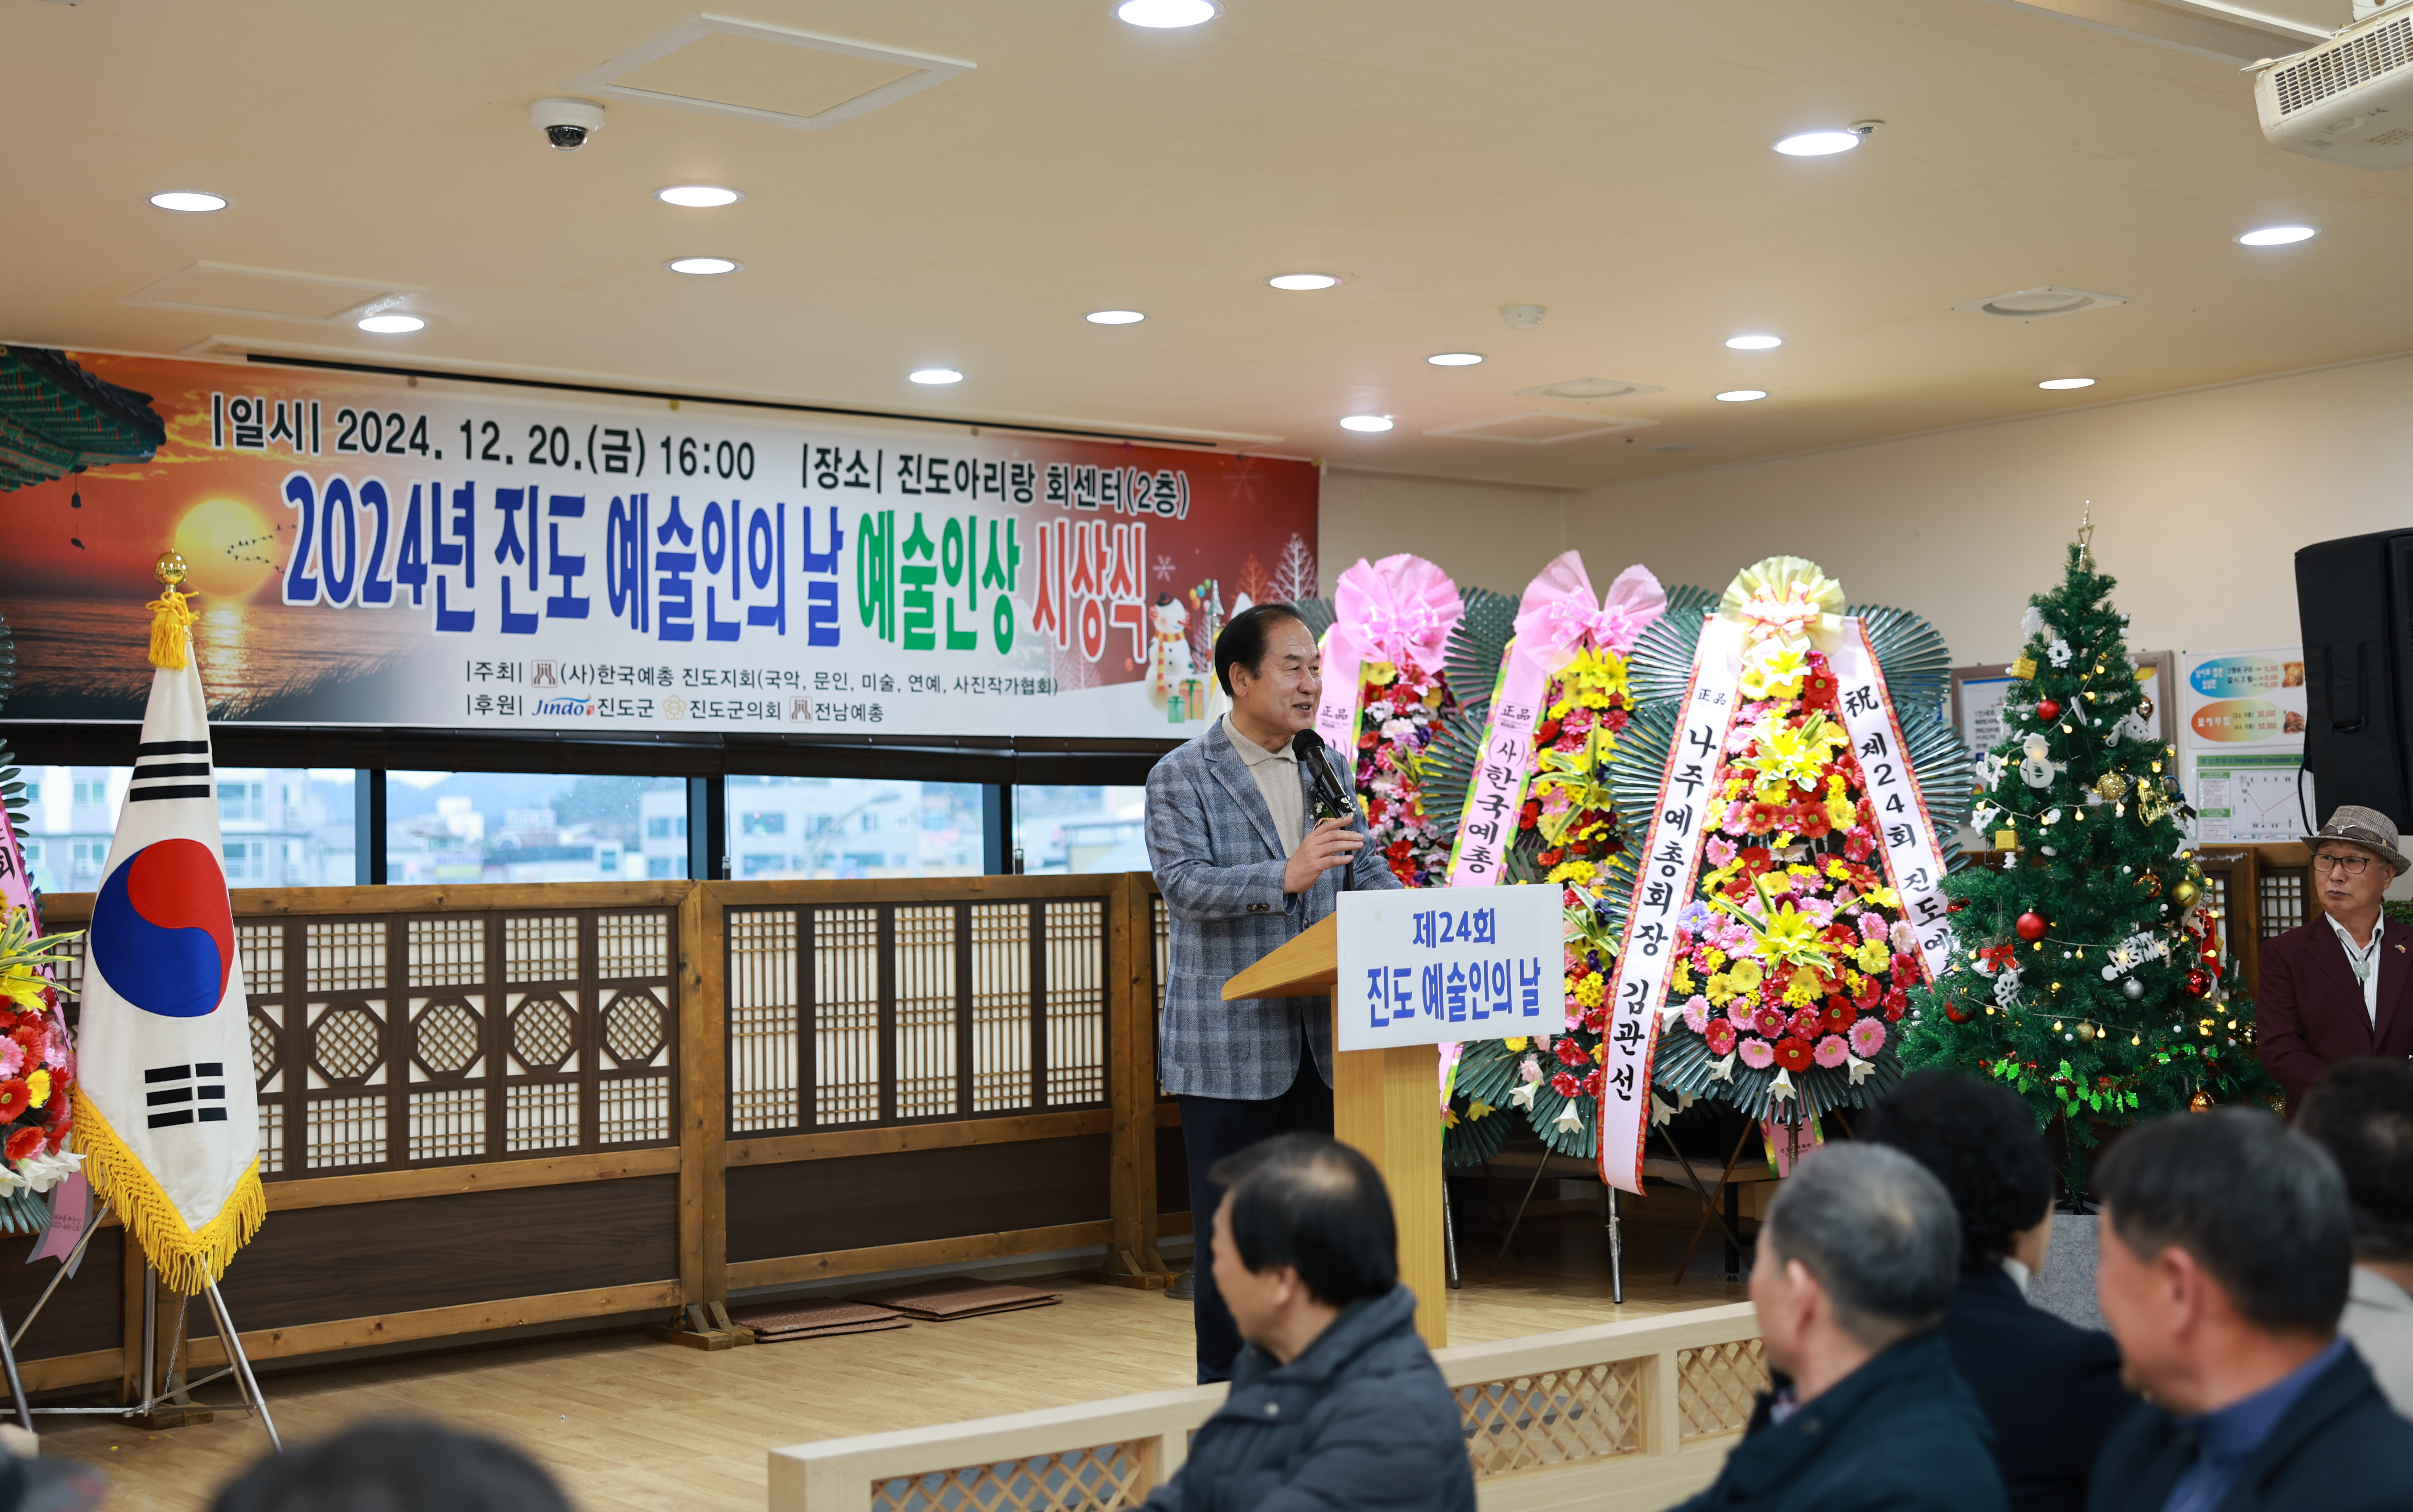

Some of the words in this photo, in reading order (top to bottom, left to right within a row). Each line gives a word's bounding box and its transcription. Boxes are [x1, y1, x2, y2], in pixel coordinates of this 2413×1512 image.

[337, 409, 442, 460] 2024.
[460, 419, 514, 465] 12.
[529, 424, 645, 477] 20.(금)
[661, 436, 755, 481] 16:00
[898, 453, 1035, 504] 진도아리랑
[1047, 464, 1189, 519] 회센터(2층)
[284, 475, 475, 632] 2024년
[495, 485, 590, 634] 진도
[606, 492, 785, 642] 예술인의
[803, 506, 844, 647] 날
[857, 510, 1020, 655] 예술인상
[1033, 522, 1146, 664] 시상식
[561, 662, 674, 687] (사)한국예총
[682, 666, 806, 690] 진도지회(국악,
[813, 671, 854, 692] 문인,
[861, 674, 901, 693] 미술,
[908, 675, 946, 694] 연예,
[954, 676, 1058, 696] 사진작가협회)
[1697, 688, 1727, 706] 正品
[1845, 685, 1879, 718] 祝
[532, 700, 584, 716] Jindo
[597, 696, 654, 718] 진도군
[689, 698, 781, 720] 진도군의회
[814, 703, 884, 723] 전남예총
[1321, 706, 1348, 720] 正品
[1500, 705, 1531, 721] 正品
[1859, 731, 1916, 849] 제24회
[1634, 725, 1716, 957] 나주예총회장
[1412, 907, 1496, 948] 제24회
[1367, 966, 1415, 1027] 진도
[1422, 958, 1513, 1023] 예술인의
[1519, 957, 1541, 1017] 날
[1609, 979, 1650, 1102] 김관선
